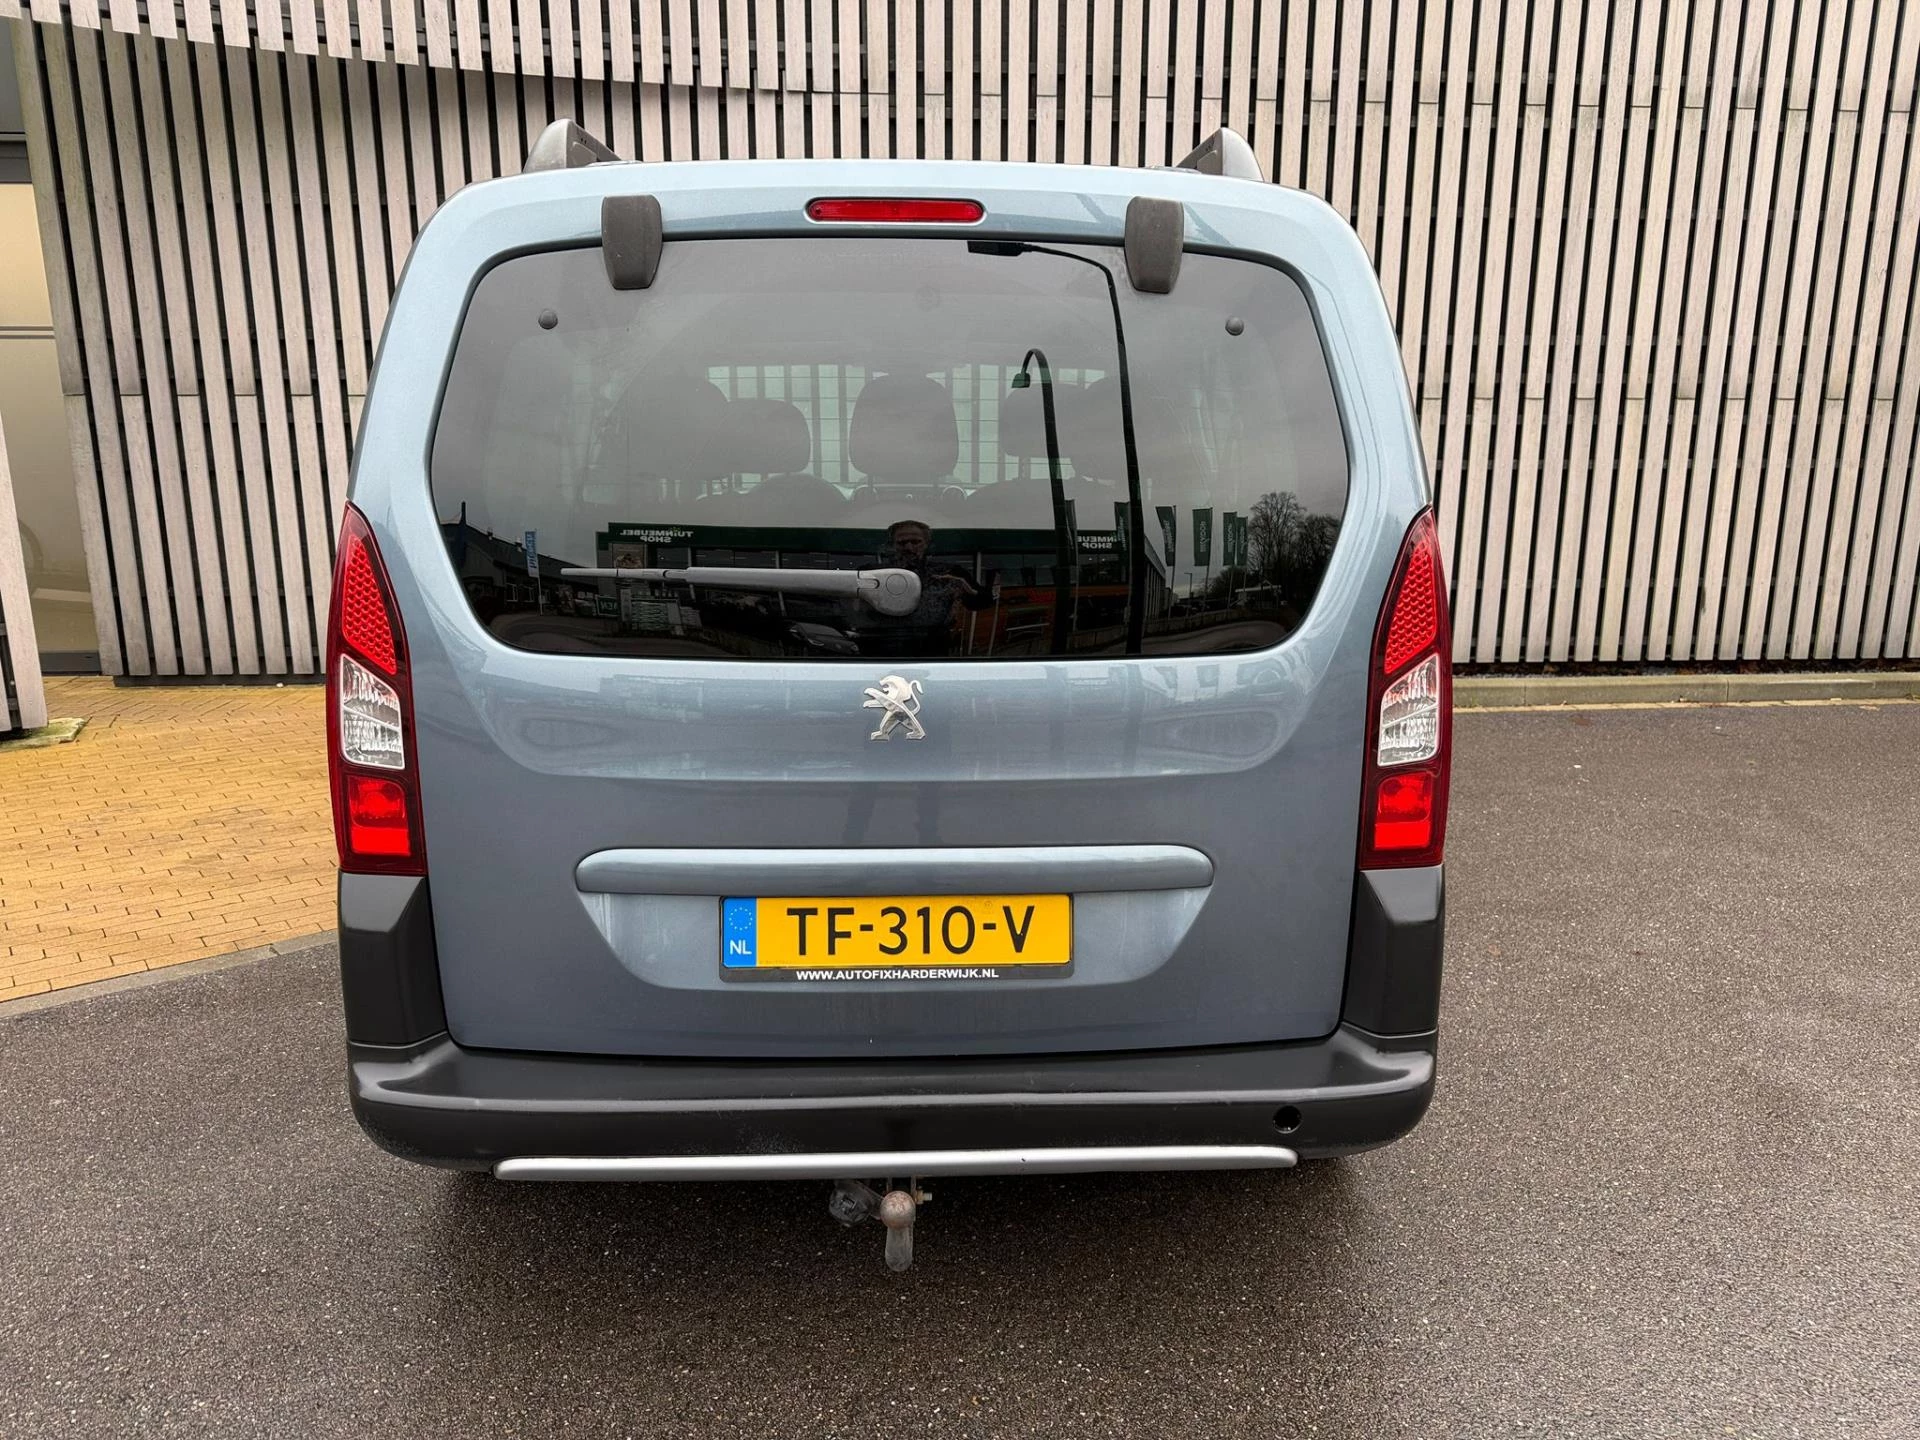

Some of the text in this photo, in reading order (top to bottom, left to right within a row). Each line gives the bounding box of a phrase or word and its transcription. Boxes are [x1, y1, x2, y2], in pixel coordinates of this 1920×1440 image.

[787, 905, 1035, 956] TF-310-V
[729, 939, 752, 955] NL
[796, 968, 999, 980] WWW.AUTOFIXHARDERWIJK.NL
